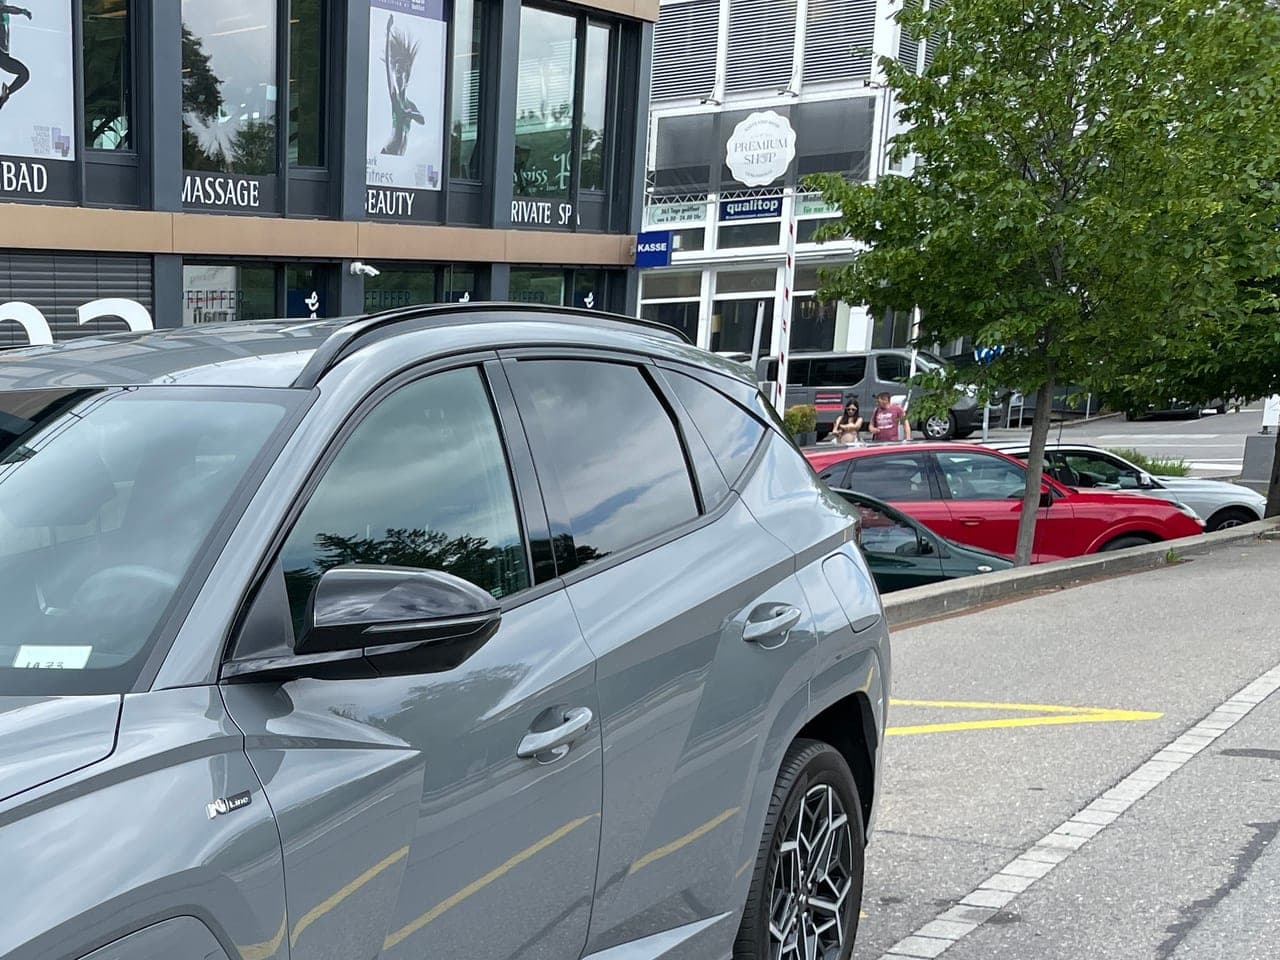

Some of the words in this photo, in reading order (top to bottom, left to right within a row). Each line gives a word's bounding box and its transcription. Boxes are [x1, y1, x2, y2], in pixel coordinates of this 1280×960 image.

[734, 137, 788, 153] PREMIUM
[744, 151, 777, 165] SHOP
[181, 175, 260, 207] MASSAGE
[365, 189, 415, 216] EAUTY
[726, 199, 779, 215] qualitop
[511, 200, 552, 224] RIVATE
[637, 242, 667, 252] KASSE
[183, 289, 245, 310] FEIFFER
